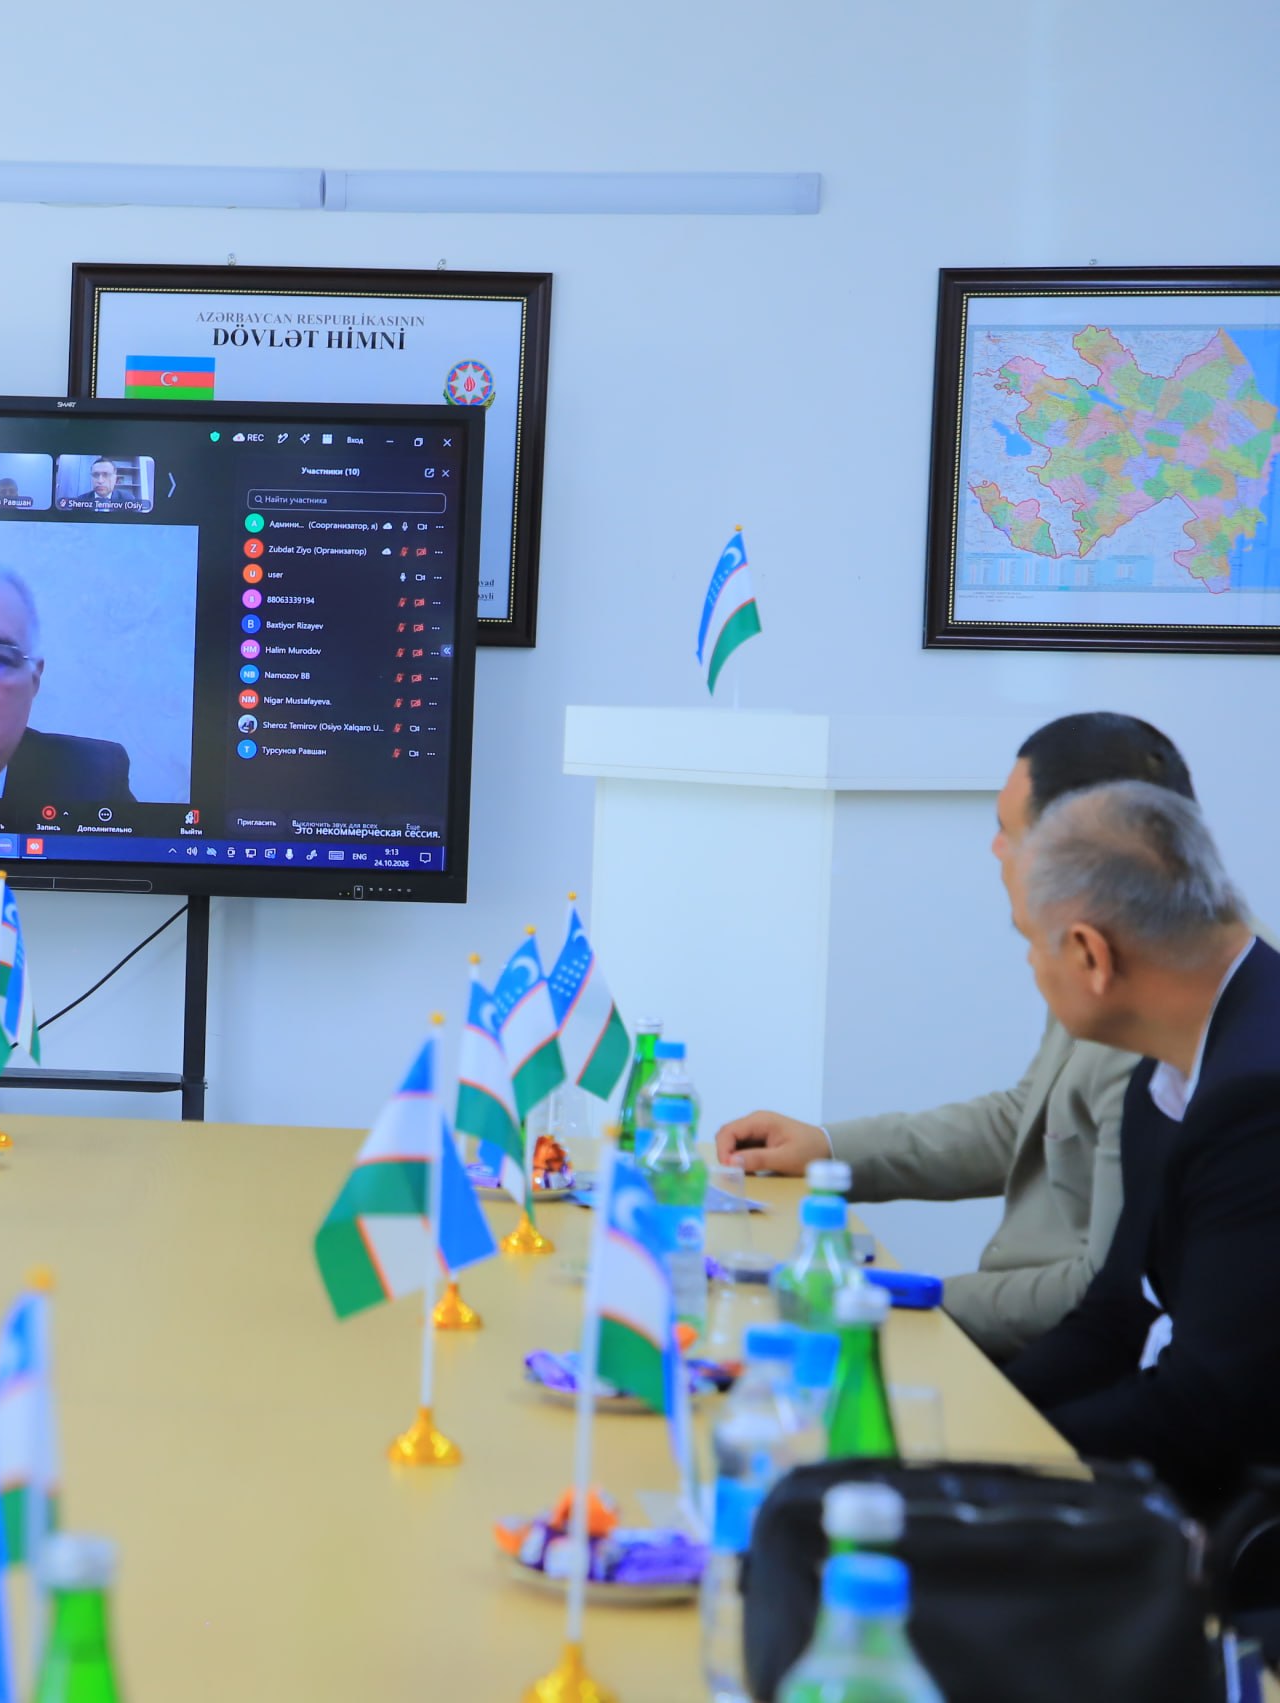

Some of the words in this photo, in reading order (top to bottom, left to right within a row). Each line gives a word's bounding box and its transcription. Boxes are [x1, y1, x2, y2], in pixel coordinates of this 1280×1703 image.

[196, 312, 293, 324] AZƏRBAYCAN
[297, 312, 425, 327] RESPUBLİKASININ
[212, 324, 319, 348] DÖVLƏT
[326, 326, 407, 350] HİMNİ
[247, 433, 264, 441] REC
[301, 467, 343, 475] Участники
[345, 468, 360, 477] (10)
[3, 498, 32, 506] Равшан
[68, 500, 93, 508] Sheroz
[265, 495, 288, 503] Найти
[289, 497, 328, 505] участника
[308, 520, 369, 531] (Соорганизатор,
[250, 544, 257, 552] Z
[268, 545, 294, 554] Zubdat
[296, 546, 312, 556] Ziyo
[313, 547, 367, 557] (Организатор)
[267, 596, 315, 604] 88063339194
[478, 592, 494, 601] əyli
[247, 620, 254, 628] B
[266, 621, 295, 630] Baxtiyor
[297, 622, 324, 631] Rizayev
[243, 645, 257, 653] HM
[265, 646, 286, 654] Halim
[288, 647, 322, 655] Murodov
[264, 671, 299, 680] Namozov
[300, 672, 310, 680] BB
[263, 696, 283, 706] Nigar
[263, 721, 287, 730] Sheroz
[289, 722, 317, 730] Temirov
[319, 723, 342, 732] (Osiyo
[343, 724, 371, 733] Xalqaro
[262, 747, 296, 756] Турсунов
[298, 747, 327, 756] Равшан
[237, 818, 277, 828] Пригласить
[292, 819, 331, 829] Выключить
[332, 822, 348, 830] звук
[36, 824, 61, 832] Запись
[77, 825, 132, 834] Дополнительно
[180, 827, 203, 836] Выйти
[294, 826, 313, 835] Это
[316, 827, 402, 839] некоммерческая
[405, 829, 441, 839] сессия.
[384, 848, 399, 856] 9:13
